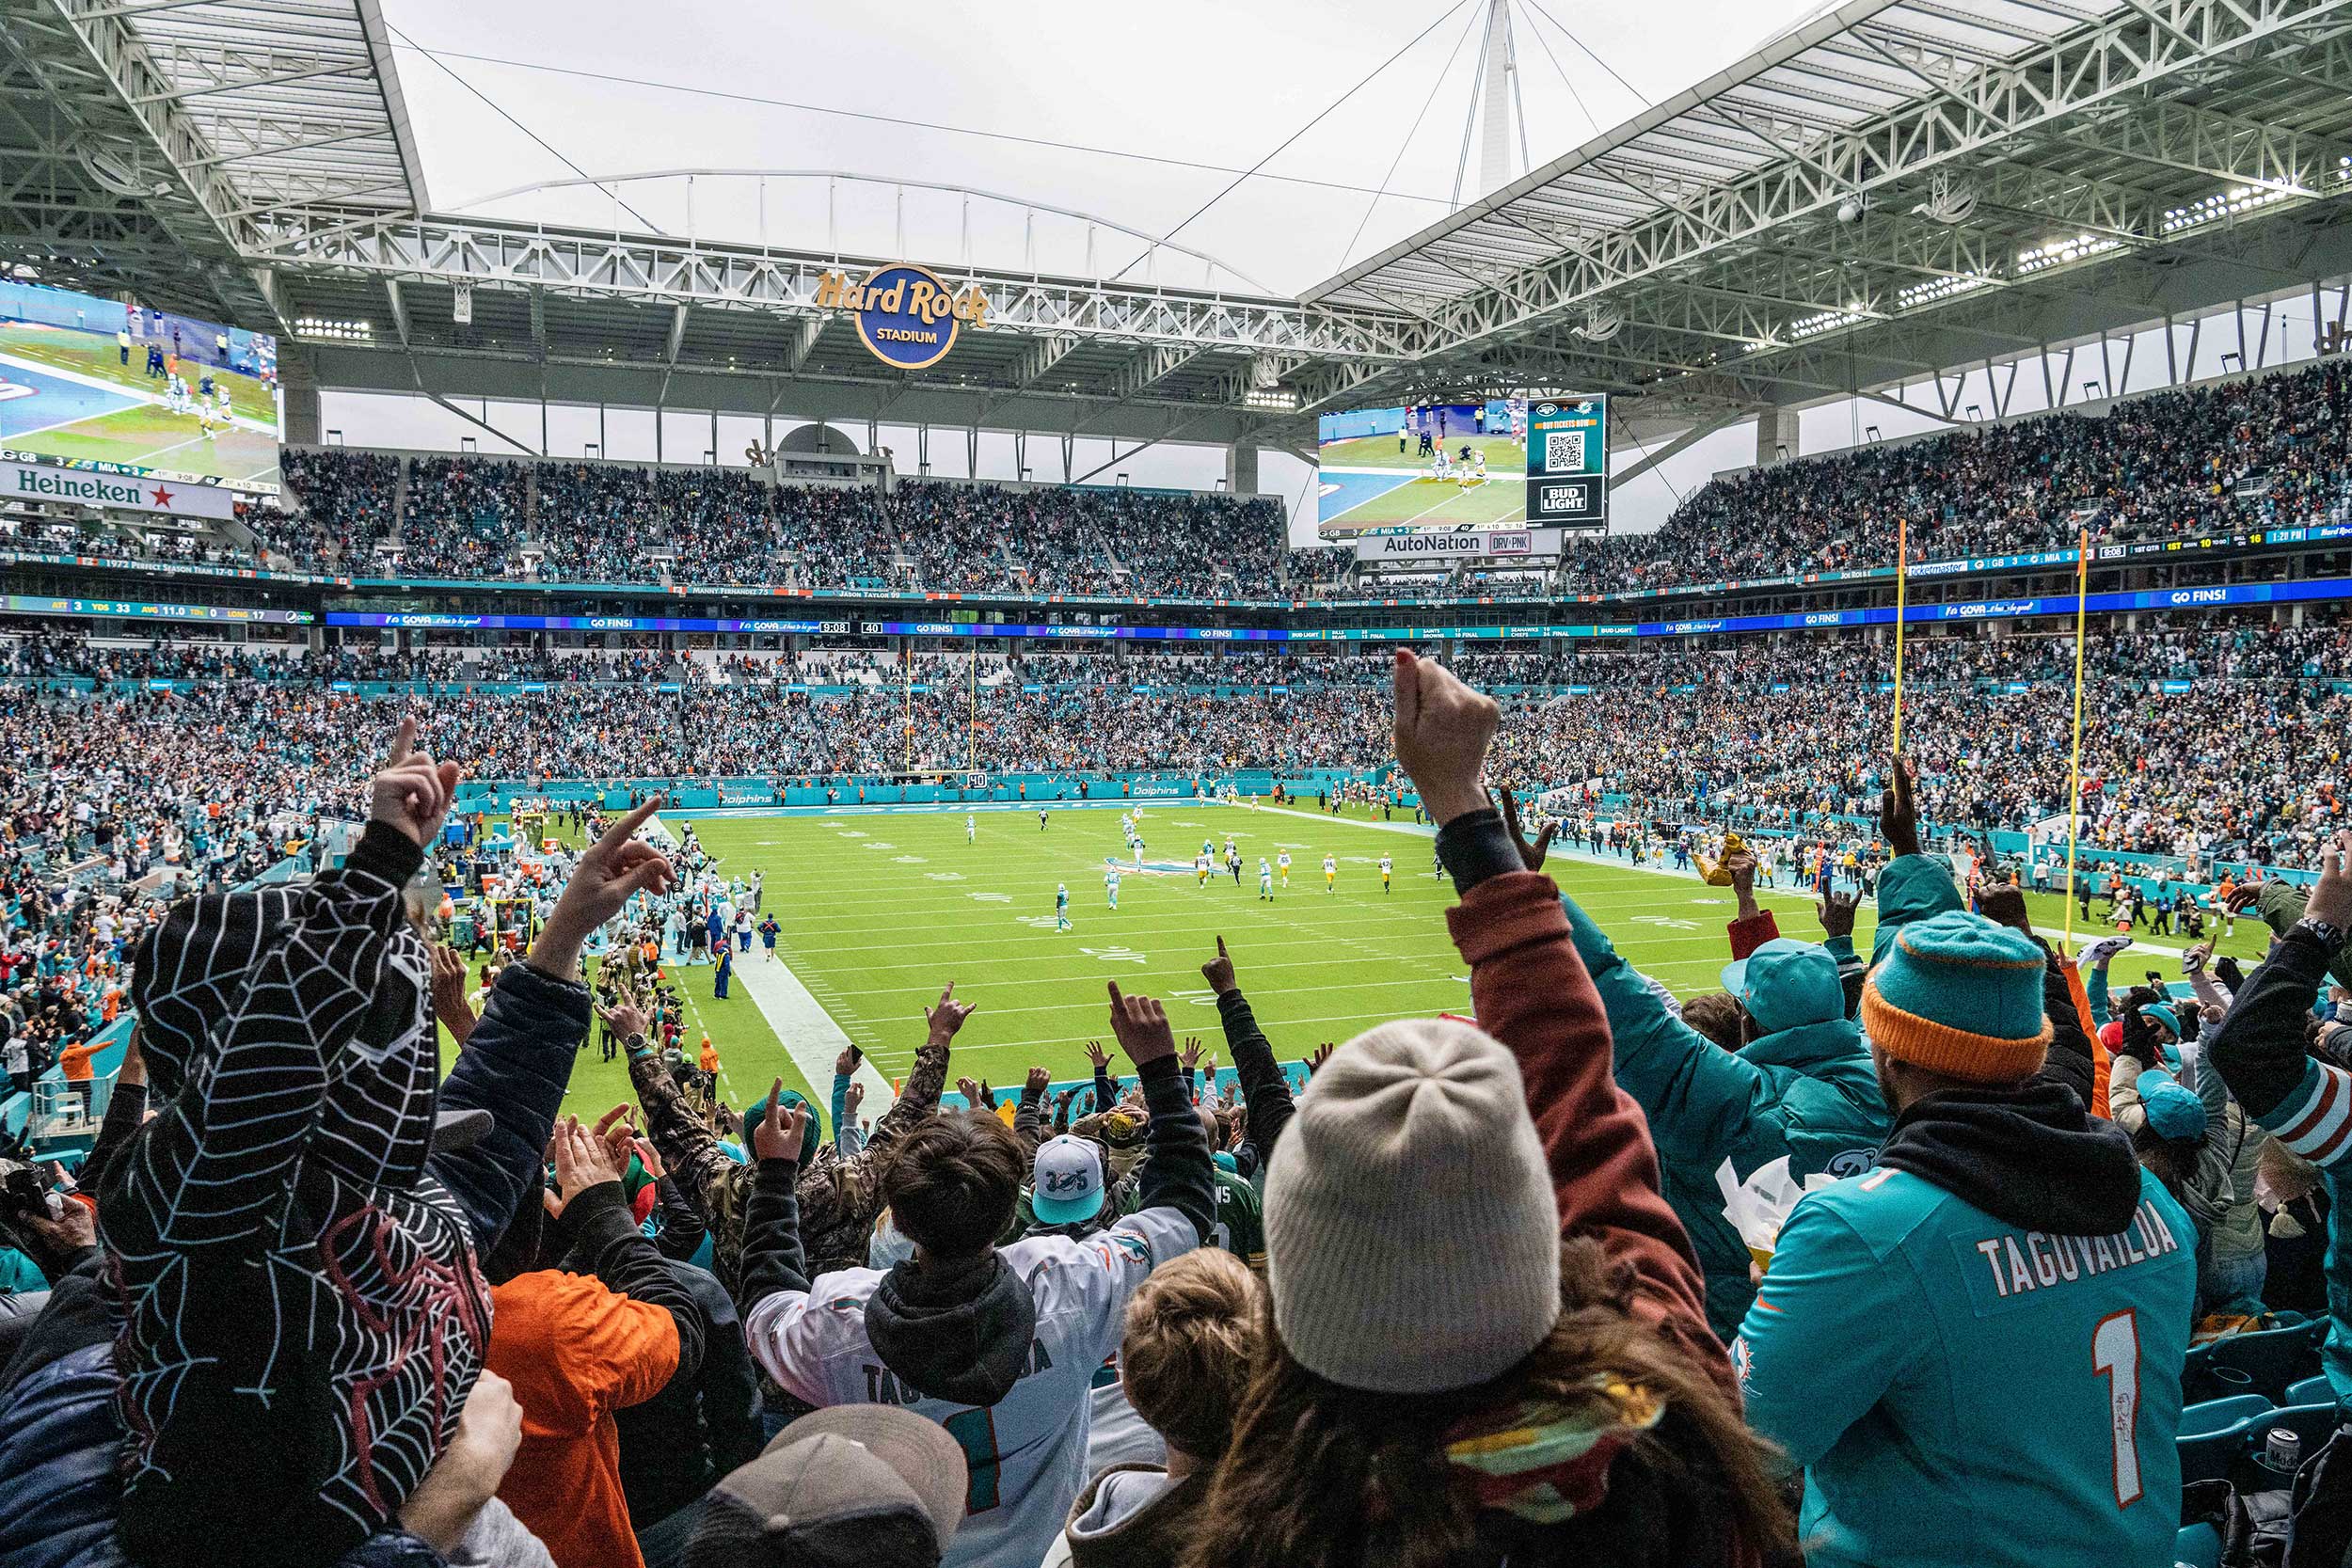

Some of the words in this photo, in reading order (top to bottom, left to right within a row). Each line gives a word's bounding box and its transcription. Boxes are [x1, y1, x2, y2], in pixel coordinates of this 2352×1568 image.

[817, 273, 906, 313] Hard
[909, 281, 989, 328] Rock
[877, 327, 938, 344] STADIUM
[19, 451, 37, 462] GB
[56, 457, 64, 466] 3
[98, 462, 119, 472] MIA
[133, 467, 138, 476] 3
[18, 469, 141, 504] Heineken
[1549, 488, 1579, 499] BUD
[1544, 499, 1584, 510] LIGHT
[2291, 531, 2302, 539] PM
[2339, 527, 2352, 535] Roc
[1385, 534, 1480, 552] AutoNation
[1493, 536, 1508, 550] DRV
[1511, 535, 1527, 548] PNK
[2167, 542, 2182, 550] 1ST
[2200, 539, 2212, 548] 10
[2249, 534, 2262, 544] 16
[2104, 547, 2122, 557] 9:08
[1992, 559, 2004, 567] GB
[2012, 557, 2018, 565] 3
[2044, 554, 2060, 562] MIA
[106, 560, 129, 568] 1972
[215, 567, 232, 577] 17-0
[1911, 563, 1963, 576] ticketmaster
[2171, 593, 2190, 604] GO
[2193, 590, 2226, 602] FINS!
[74, 602, 82, 610] 3
[116, 604, 130, 612] 33
[163, 607, 185, 616] 11.0
[210, 609, 216, 617] 0
[252, 611, 264, 620] 17
[1960, 605, 1986, 615] GOYA
[403, 615, 431, 625] GOYA
[591, 619, 605, 627] GO
[608, 619, 633, 627] FINS!
[1806, 616, 1817, 625] GO
[1819, 614, 1838, 623] FINS!
[754, 622, 778, 630] GOYA
[823, 623, 846, 632] 9:08
[866, 624, 879, 633] 40
[931, 625, 953, 633] FINS!
[970, 776, 985, 786] 40
[1133, 786, 1179, 797] Dolphins
[721, 794, 773, 805] Dolphins
[2091, 1307, 2145, 1512] 1
